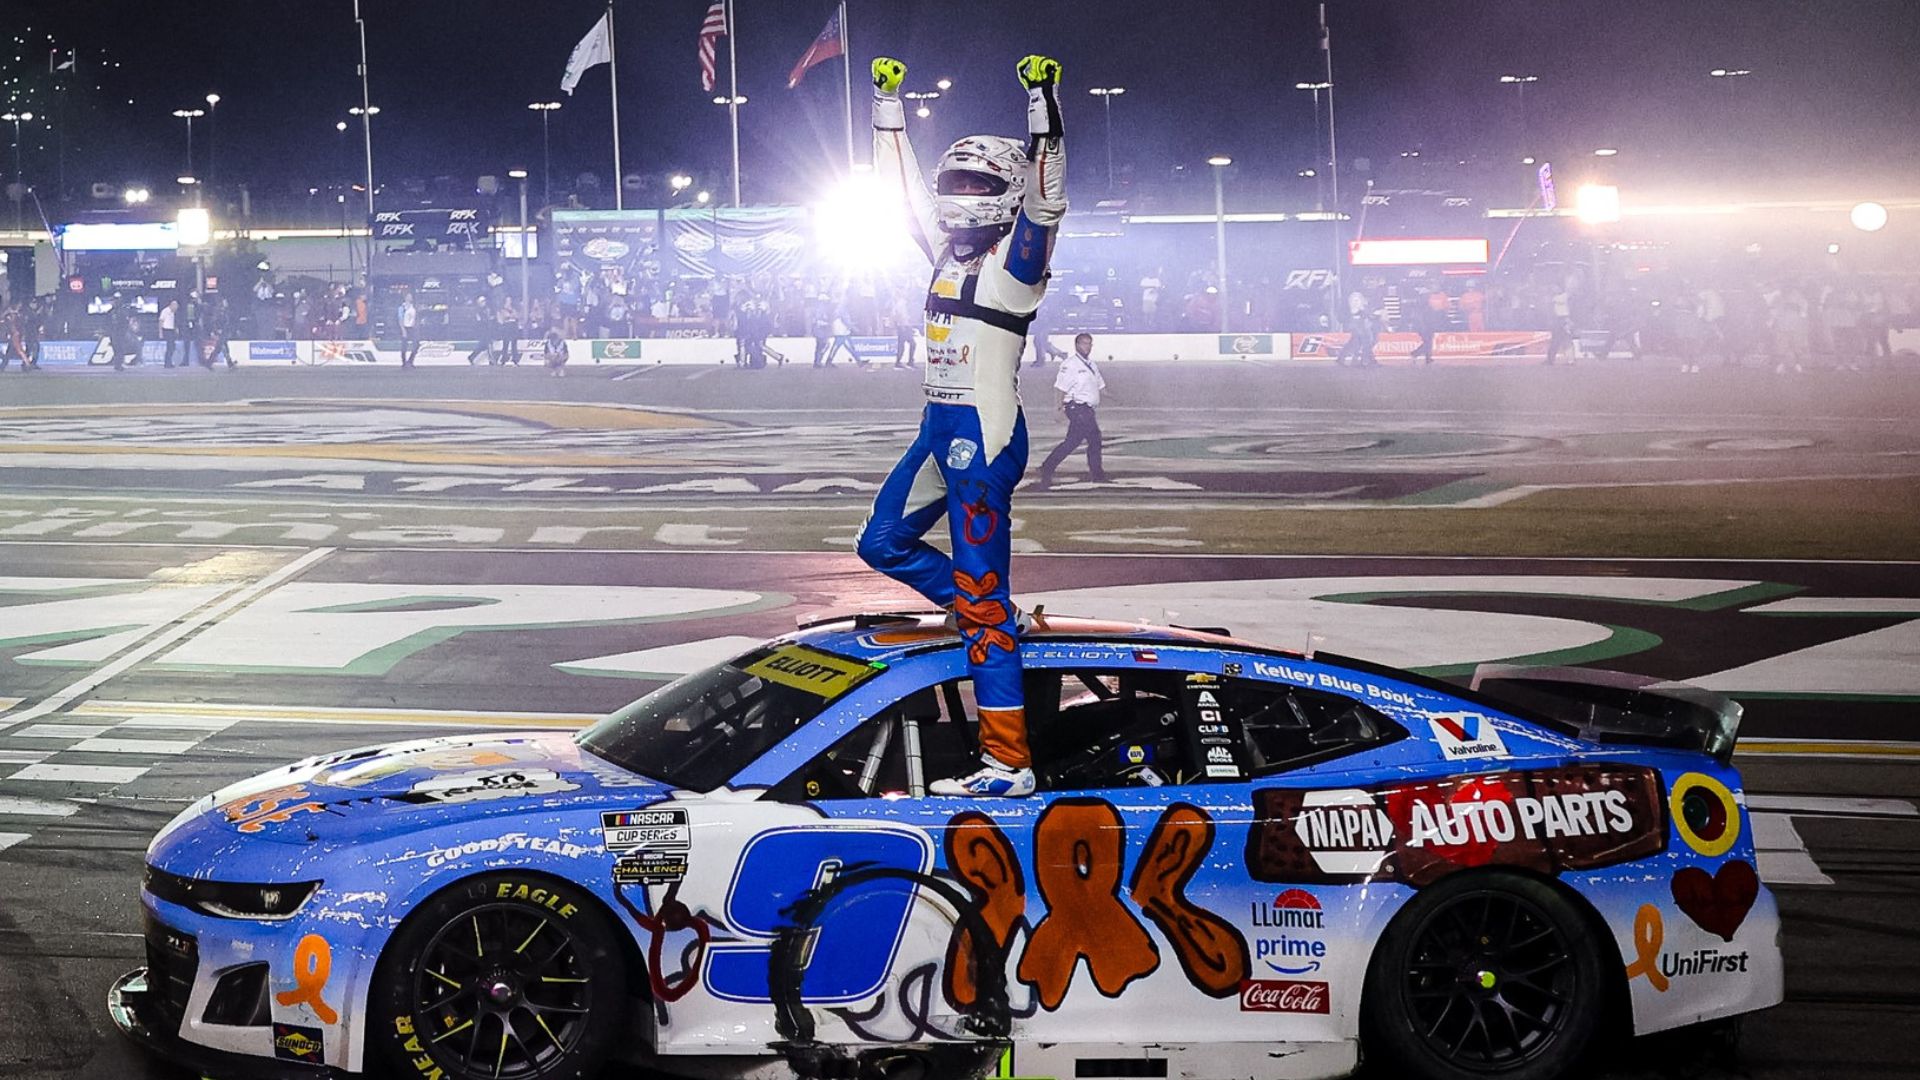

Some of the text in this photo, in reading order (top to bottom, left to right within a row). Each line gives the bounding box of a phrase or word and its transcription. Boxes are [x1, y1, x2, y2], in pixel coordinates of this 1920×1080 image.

[376, 212, 402, 222] RFK
[450, 209, 478, 220] RFK
[382, 223, 415, 235] RFK
[446, 222, 480, 235] RFK
[151, 280, 177, 288] JGR
[1043, 650, 1128, 659] ELLIOTT
[765, 656, 847, 682] ELLIOTT
[1253, 662, 1414, 707] Kelley Blue Book
[1448, 743, 1498, 756] Valvoline
[630, 812, 675, 825] NASCAR
[1309, 809, 1382, 848] NAPA
[1405, 790, 1634, 848] AUTO PARTS
[616, 828, 677, 842] CUP SERIES
[427, 833, 584, 868] GOODYEAR
[613, 866, 685, 874] CHALLENGE
[496, 882, 579, 919] EAGLE
[703, 825, 930, 1003] 9
[1252, 902, 1324, 929] LLumar
[1256, 934, 1326, 960] prime
[1663, 949, 1749, 978] UniFirst
[1243, 982, 1326, 1011] Coca-Cola
[276, 1036, 321, 1053] SUNOCO
[395, 1015, 444, 1080] YEAR
